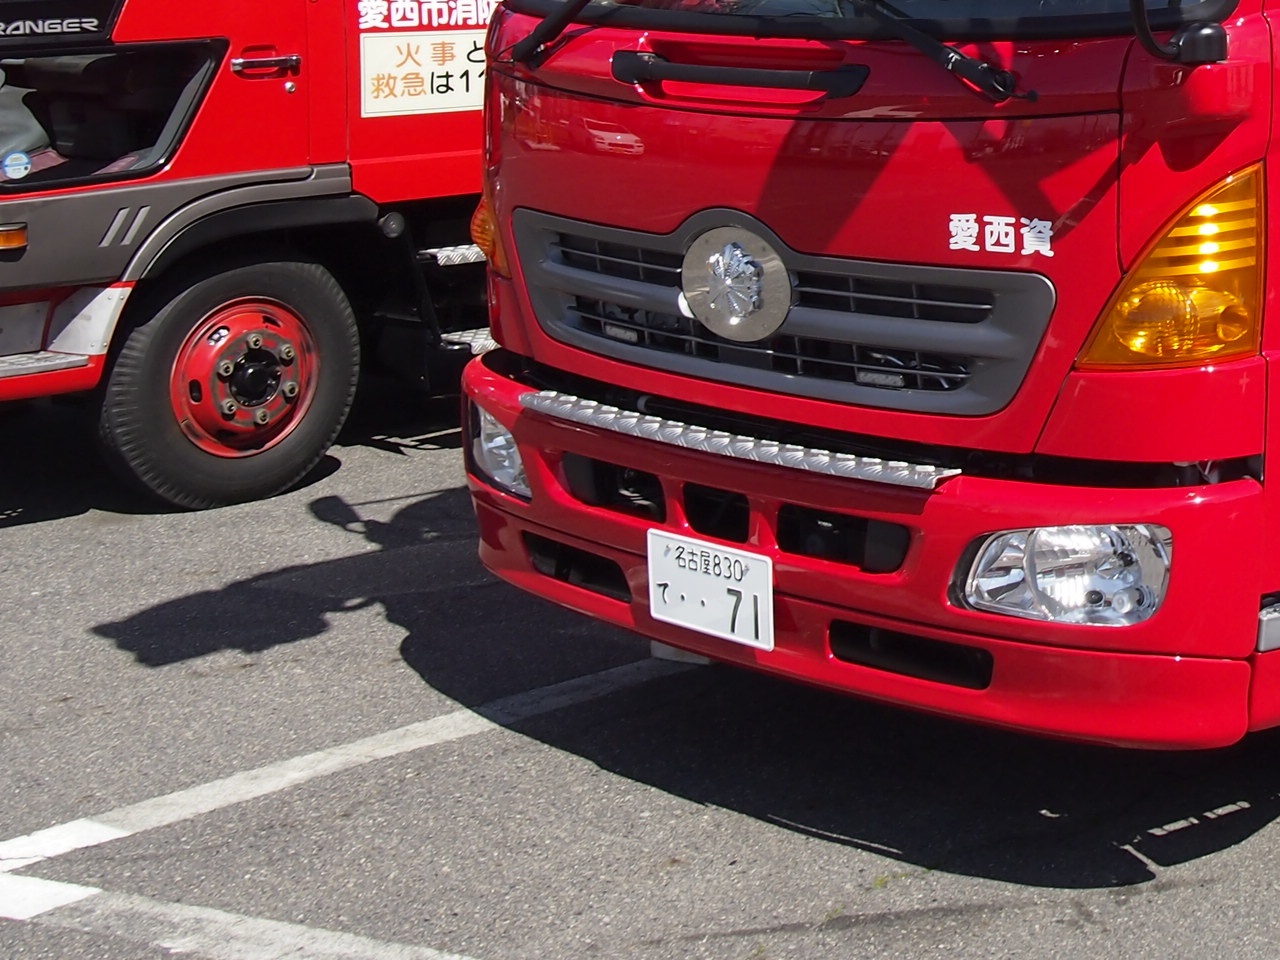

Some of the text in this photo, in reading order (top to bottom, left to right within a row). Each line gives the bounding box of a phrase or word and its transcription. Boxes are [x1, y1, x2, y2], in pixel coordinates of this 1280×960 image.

[371, 69, 486, 100] 救急は1
[949, 213, 1054, 257] 愛西資
